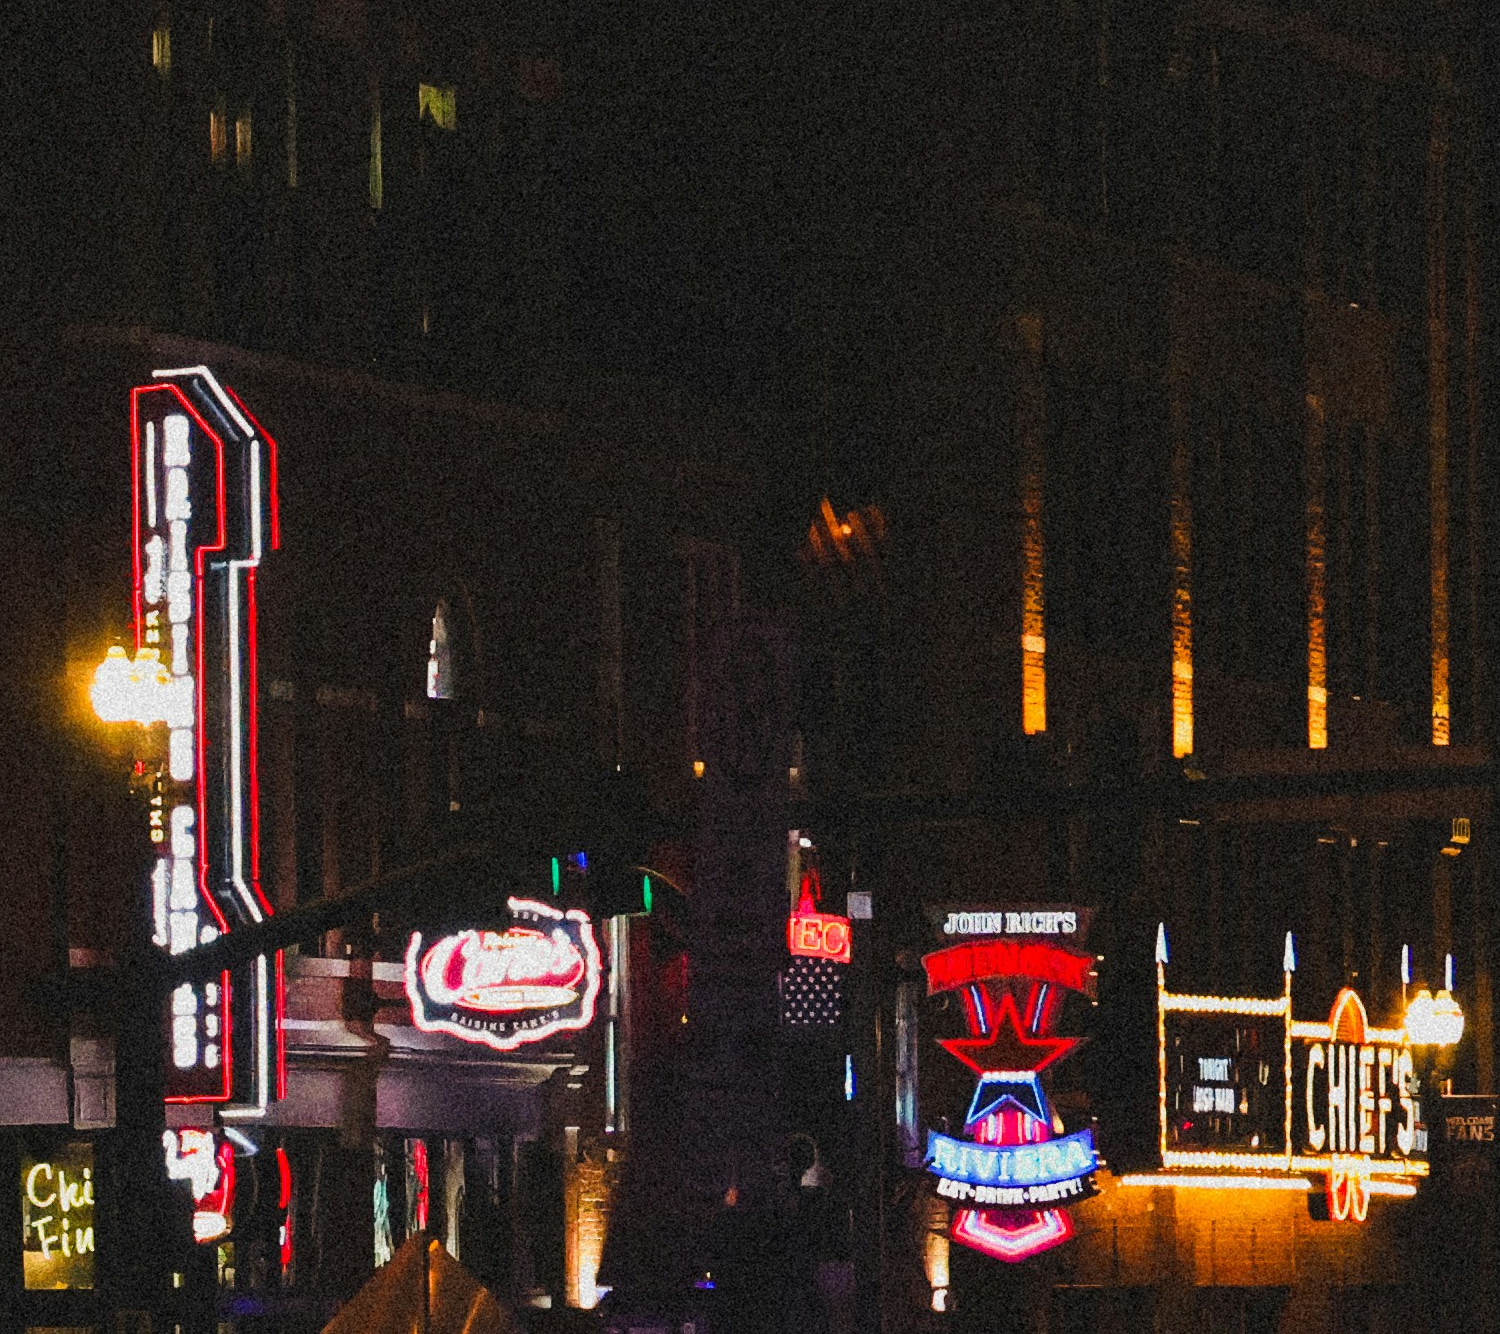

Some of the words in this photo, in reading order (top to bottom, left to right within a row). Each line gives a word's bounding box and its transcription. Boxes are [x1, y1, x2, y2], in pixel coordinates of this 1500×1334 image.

[943, 912, 1002, 935] JOHN
[1005, 911, 1077, 935] RICH'S
[1305, 1042, 1416, 1157] CHIEF'S
[930, 1136, 1092, 1182] RIVIERA
[935, 1177, 971, 1201] EAT
